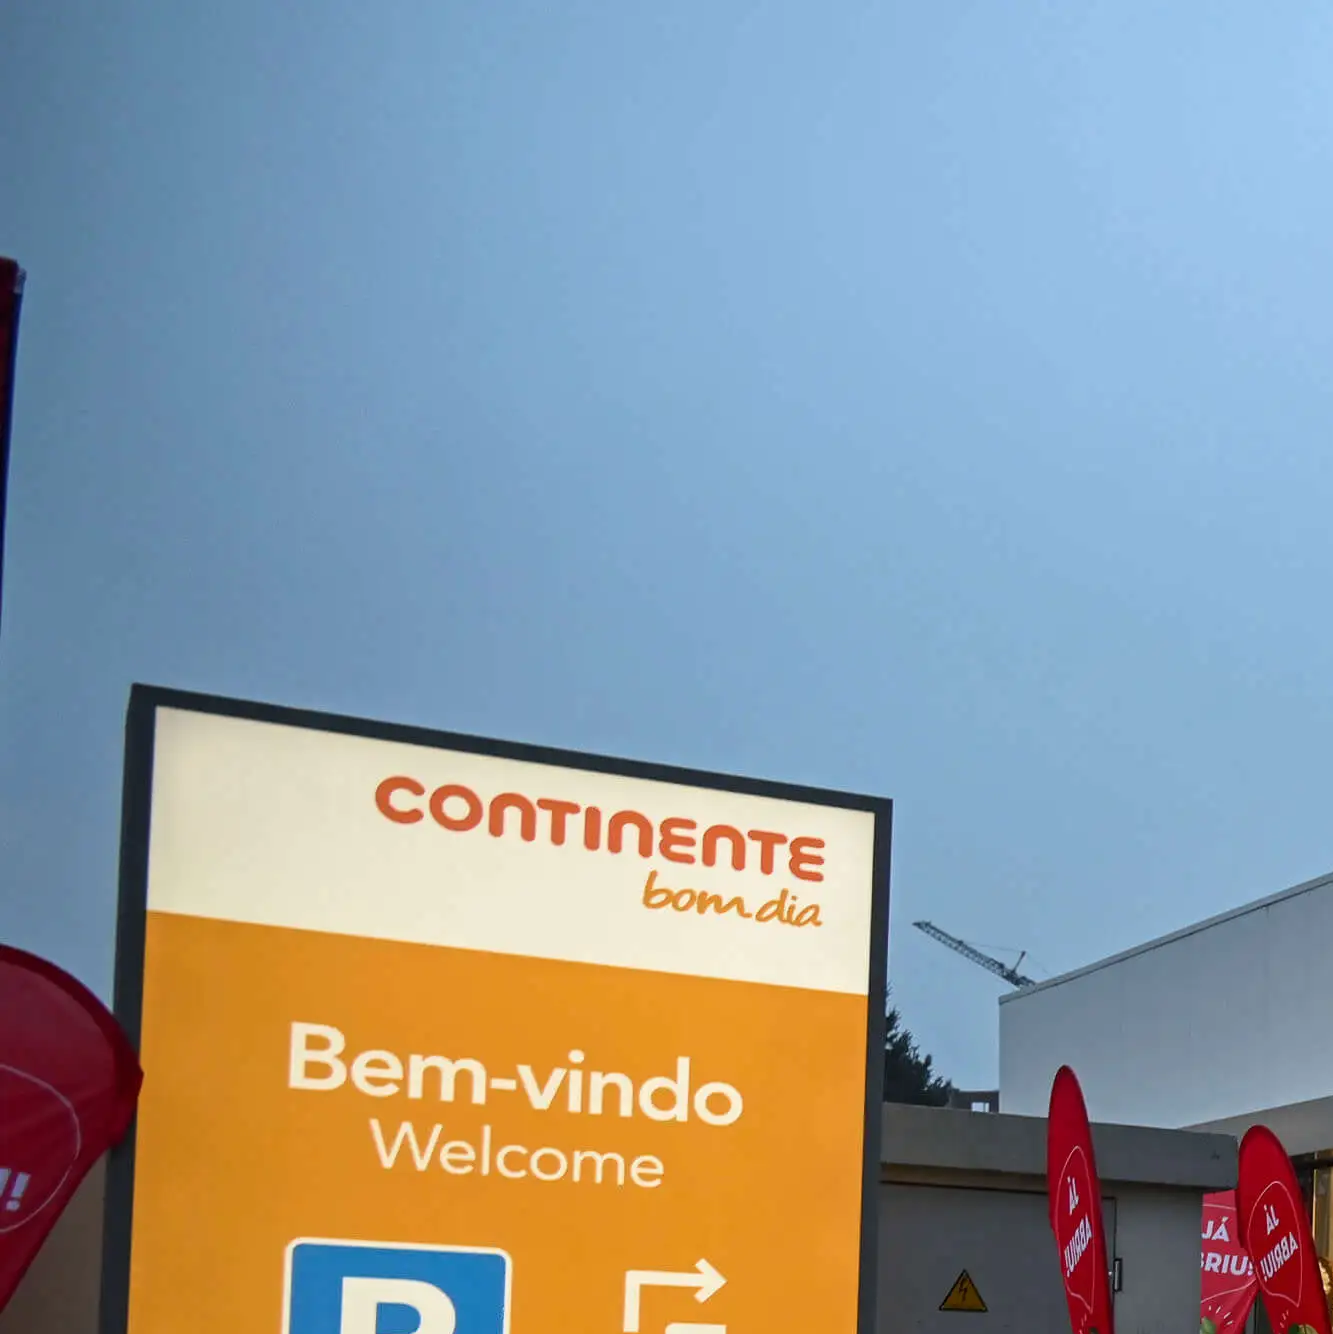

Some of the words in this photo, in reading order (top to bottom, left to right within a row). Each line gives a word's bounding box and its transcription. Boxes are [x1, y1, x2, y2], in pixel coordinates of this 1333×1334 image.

[375, 775, 826, 883] CONTINENTE
[643, 870, 752, 919] bom
[755, 888, 824, 928] dia
[288, 1020, 744, 1127] Bem-vindo
[369, 1118, 665, 1188] Welcome
[1202, 1216, 1230, 1242] JÁ
[1200, 1252, 1254, 1277] RIU!
